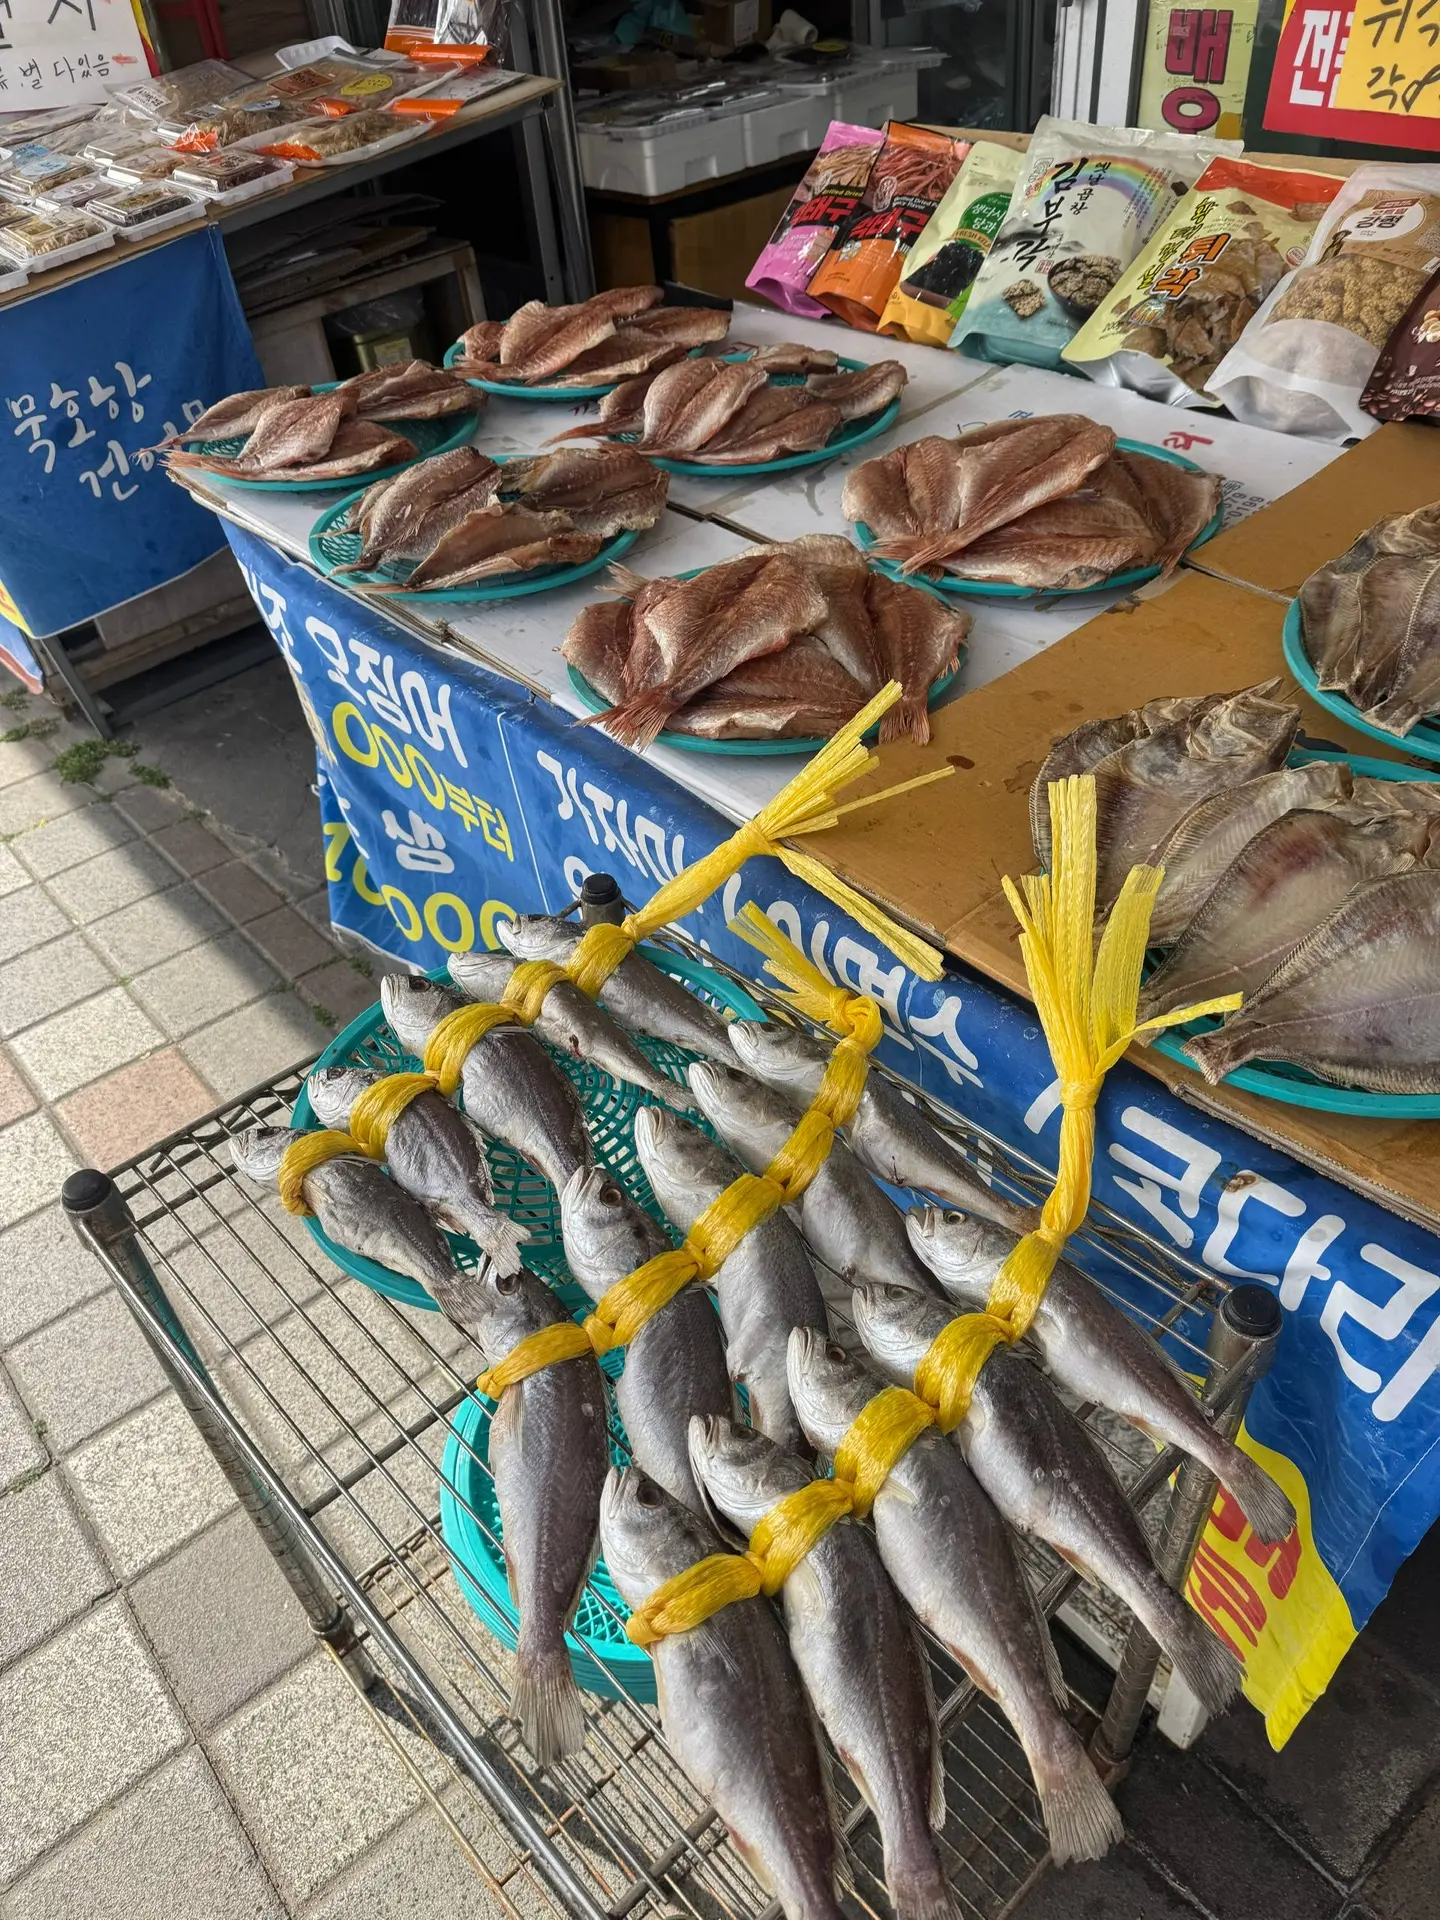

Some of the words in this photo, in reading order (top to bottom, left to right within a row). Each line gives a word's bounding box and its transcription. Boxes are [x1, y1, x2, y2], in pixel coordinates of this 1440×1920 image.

[914, 198, 931, 206] Dried
[1012, 157, 1089, 272] 김부각
[1355, 215, 1405, 229] 강정
[955, 230, 978, 240] FRESH
[1150, 232, 1233, 300] 튀각
[1108, 1105, 1440, 1422] 코다리
